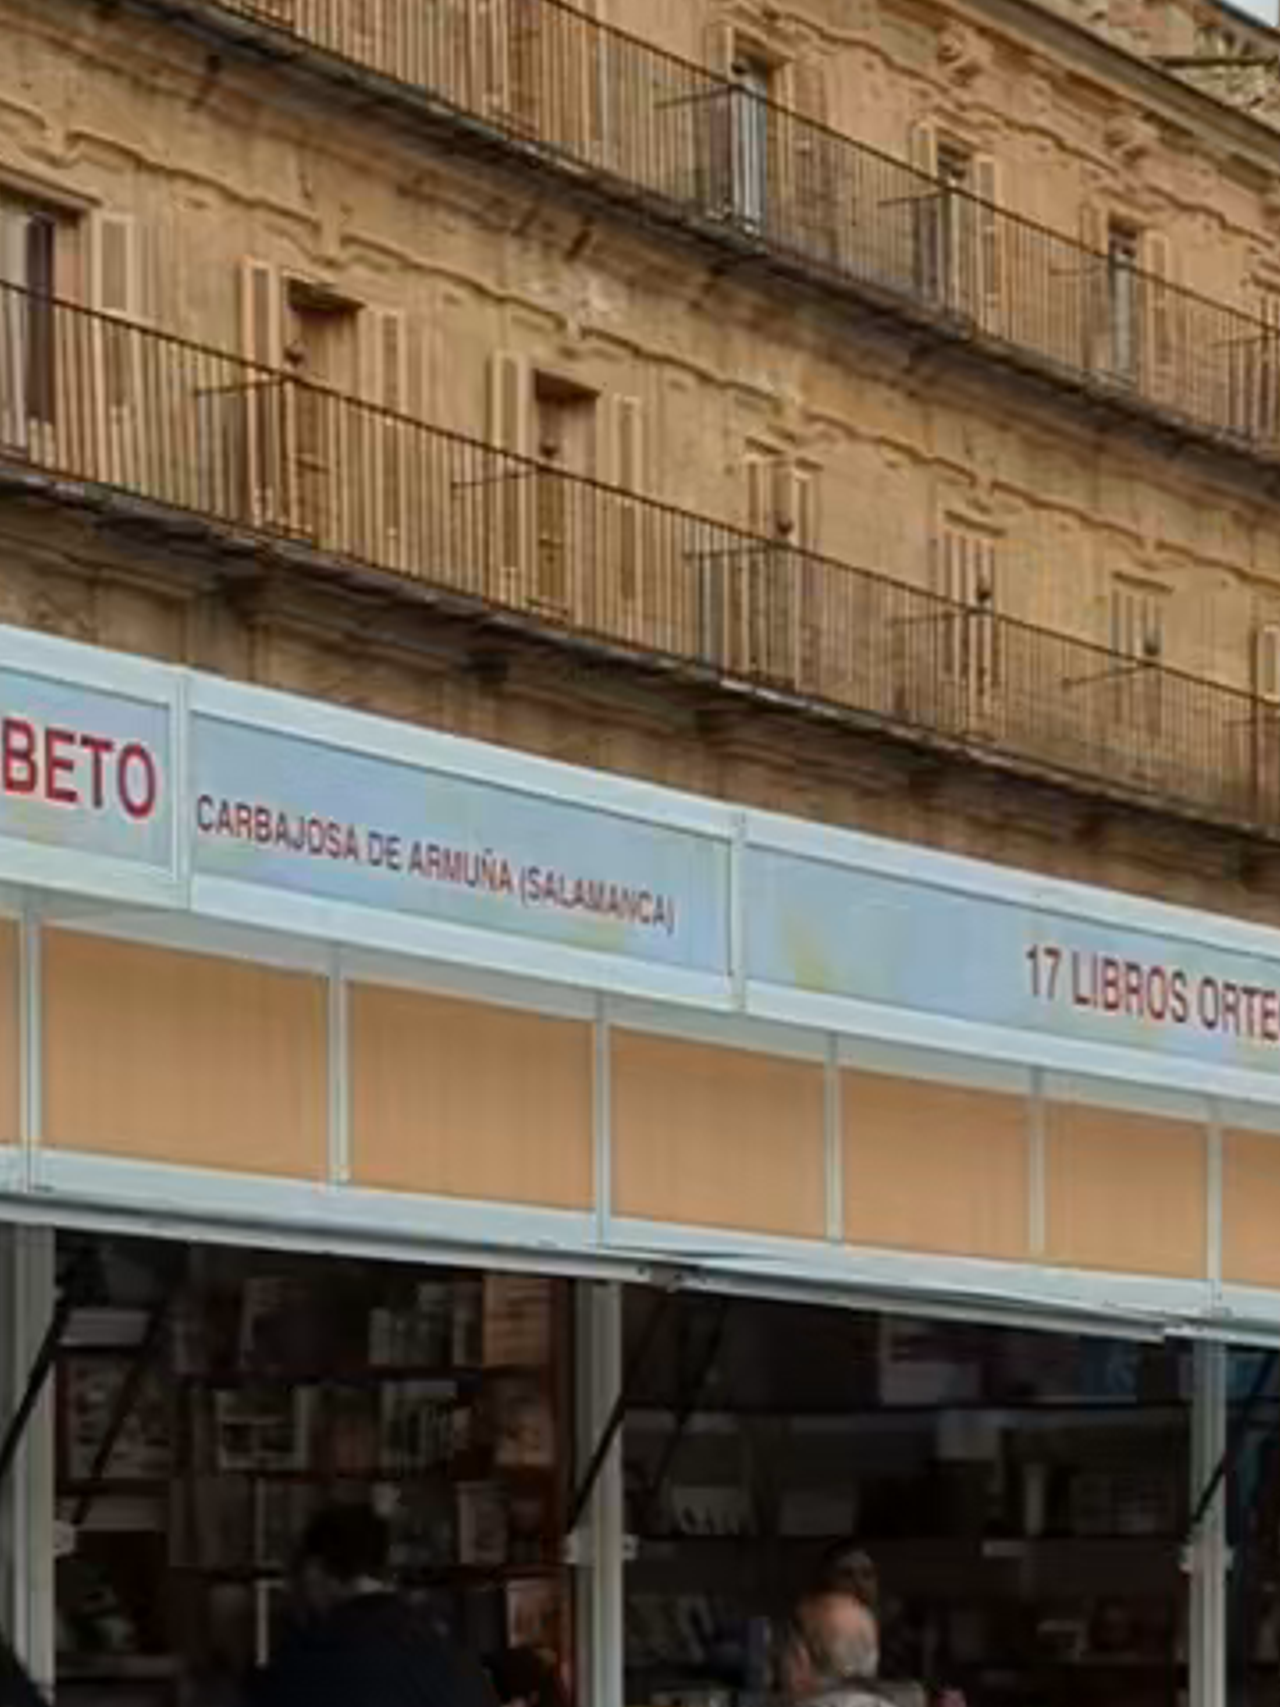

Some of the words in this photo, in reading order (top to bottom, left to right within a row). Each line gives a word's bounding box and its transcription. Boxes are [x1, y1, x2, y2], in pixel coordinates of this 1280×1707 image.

[196, 794, 359, 861] CARBAJOSA
[367, 830, 403, 871] DE
[408, 840, 513, 894] ARMUÑA
[520, 865, 675, 936] (SALAMANCA)
[1026, 943, 1061, 999] 17
[1072, 951, 1188, 1023] LIBROS
